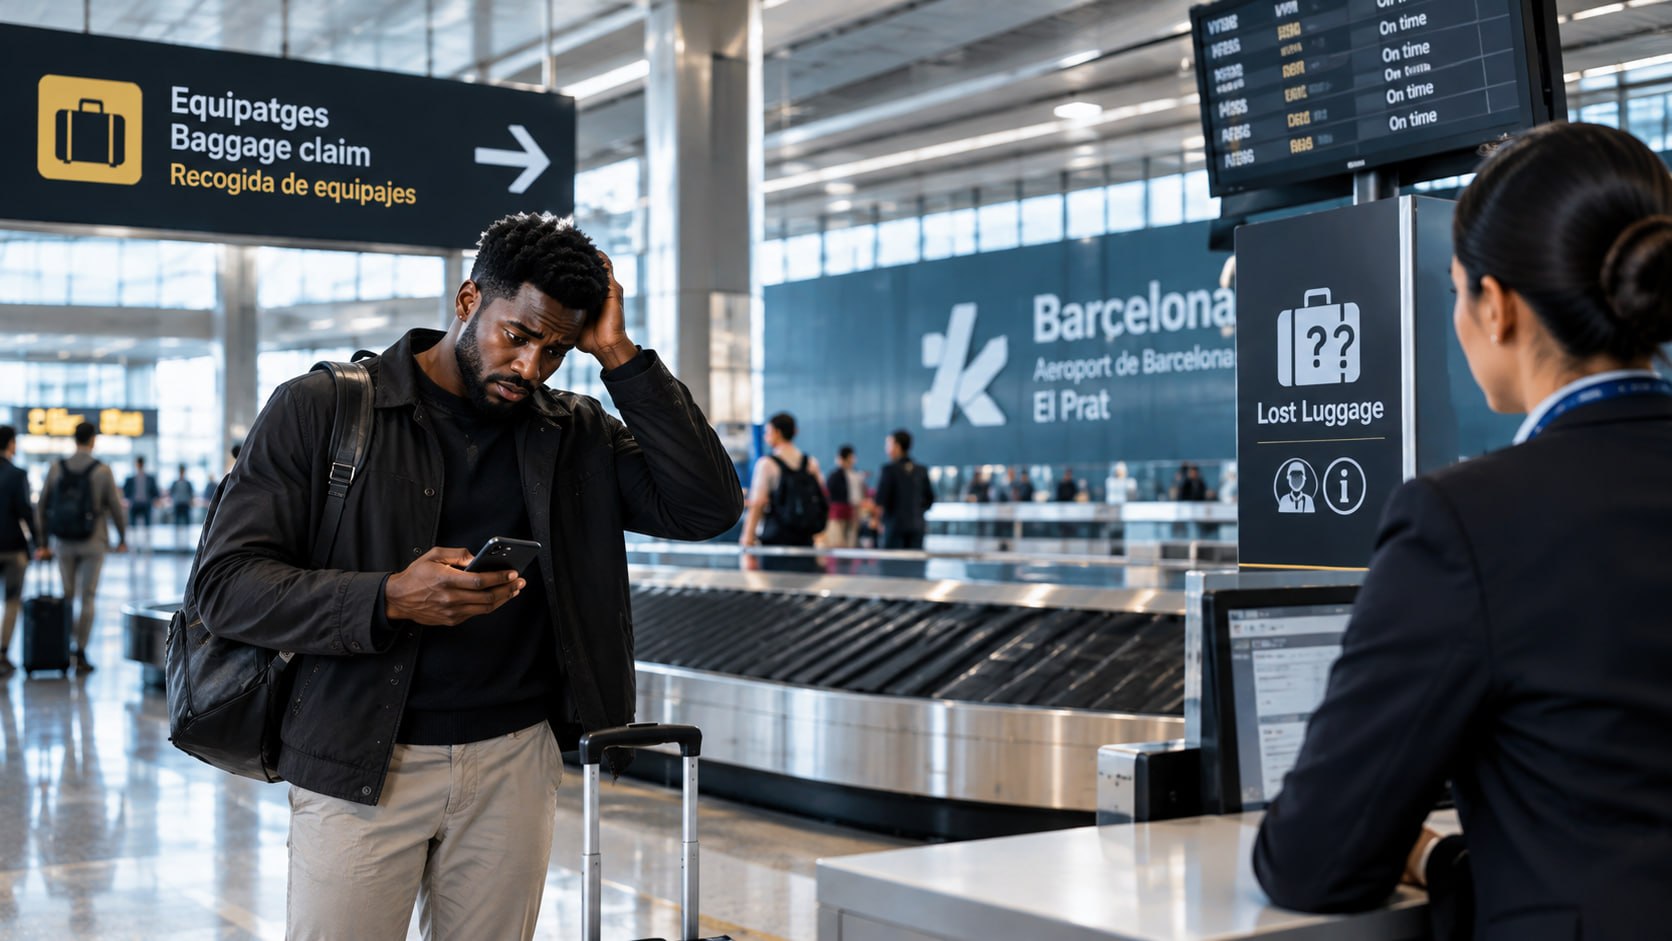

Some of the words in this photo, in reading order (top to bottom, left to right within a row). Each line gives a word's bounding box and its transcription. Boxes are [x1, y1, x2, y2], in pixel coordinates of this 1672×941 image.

[1379, 21, 1397, 35] On
[1399, 13, 1427, 31] time
[1382, 48, 1400, 63] On
[1402, 41, 1430, 59] time
[1384, 68, 1401, 82] On
[1386, 89, 1404, 104] On
[1406, 82, 1434, 99] time
[171, 86, 329, 131] Equipatges
[1389, 116, 1407, 131] On
[1409, 110, 1437, 127] time
[171, 123, 292, 164] Baggage
[299, 136, 371, 167] claim
[170, 163, 275, 195] Recogida
[281, 172, 309, 196] de
[314, 178, 417, 208] equipajes
[1033, 354, 1113, 385] Aeroport
[1115, 351, 1140, 377] de
[1142, 344, 1235, 375] Barcelona
[1033, 389, 1056, 423] El
[1060, 388, 1111, 422] Prat
[1257, 401, 1297, 424] Lost
[1302, 400, 1385, 426] Luggage
